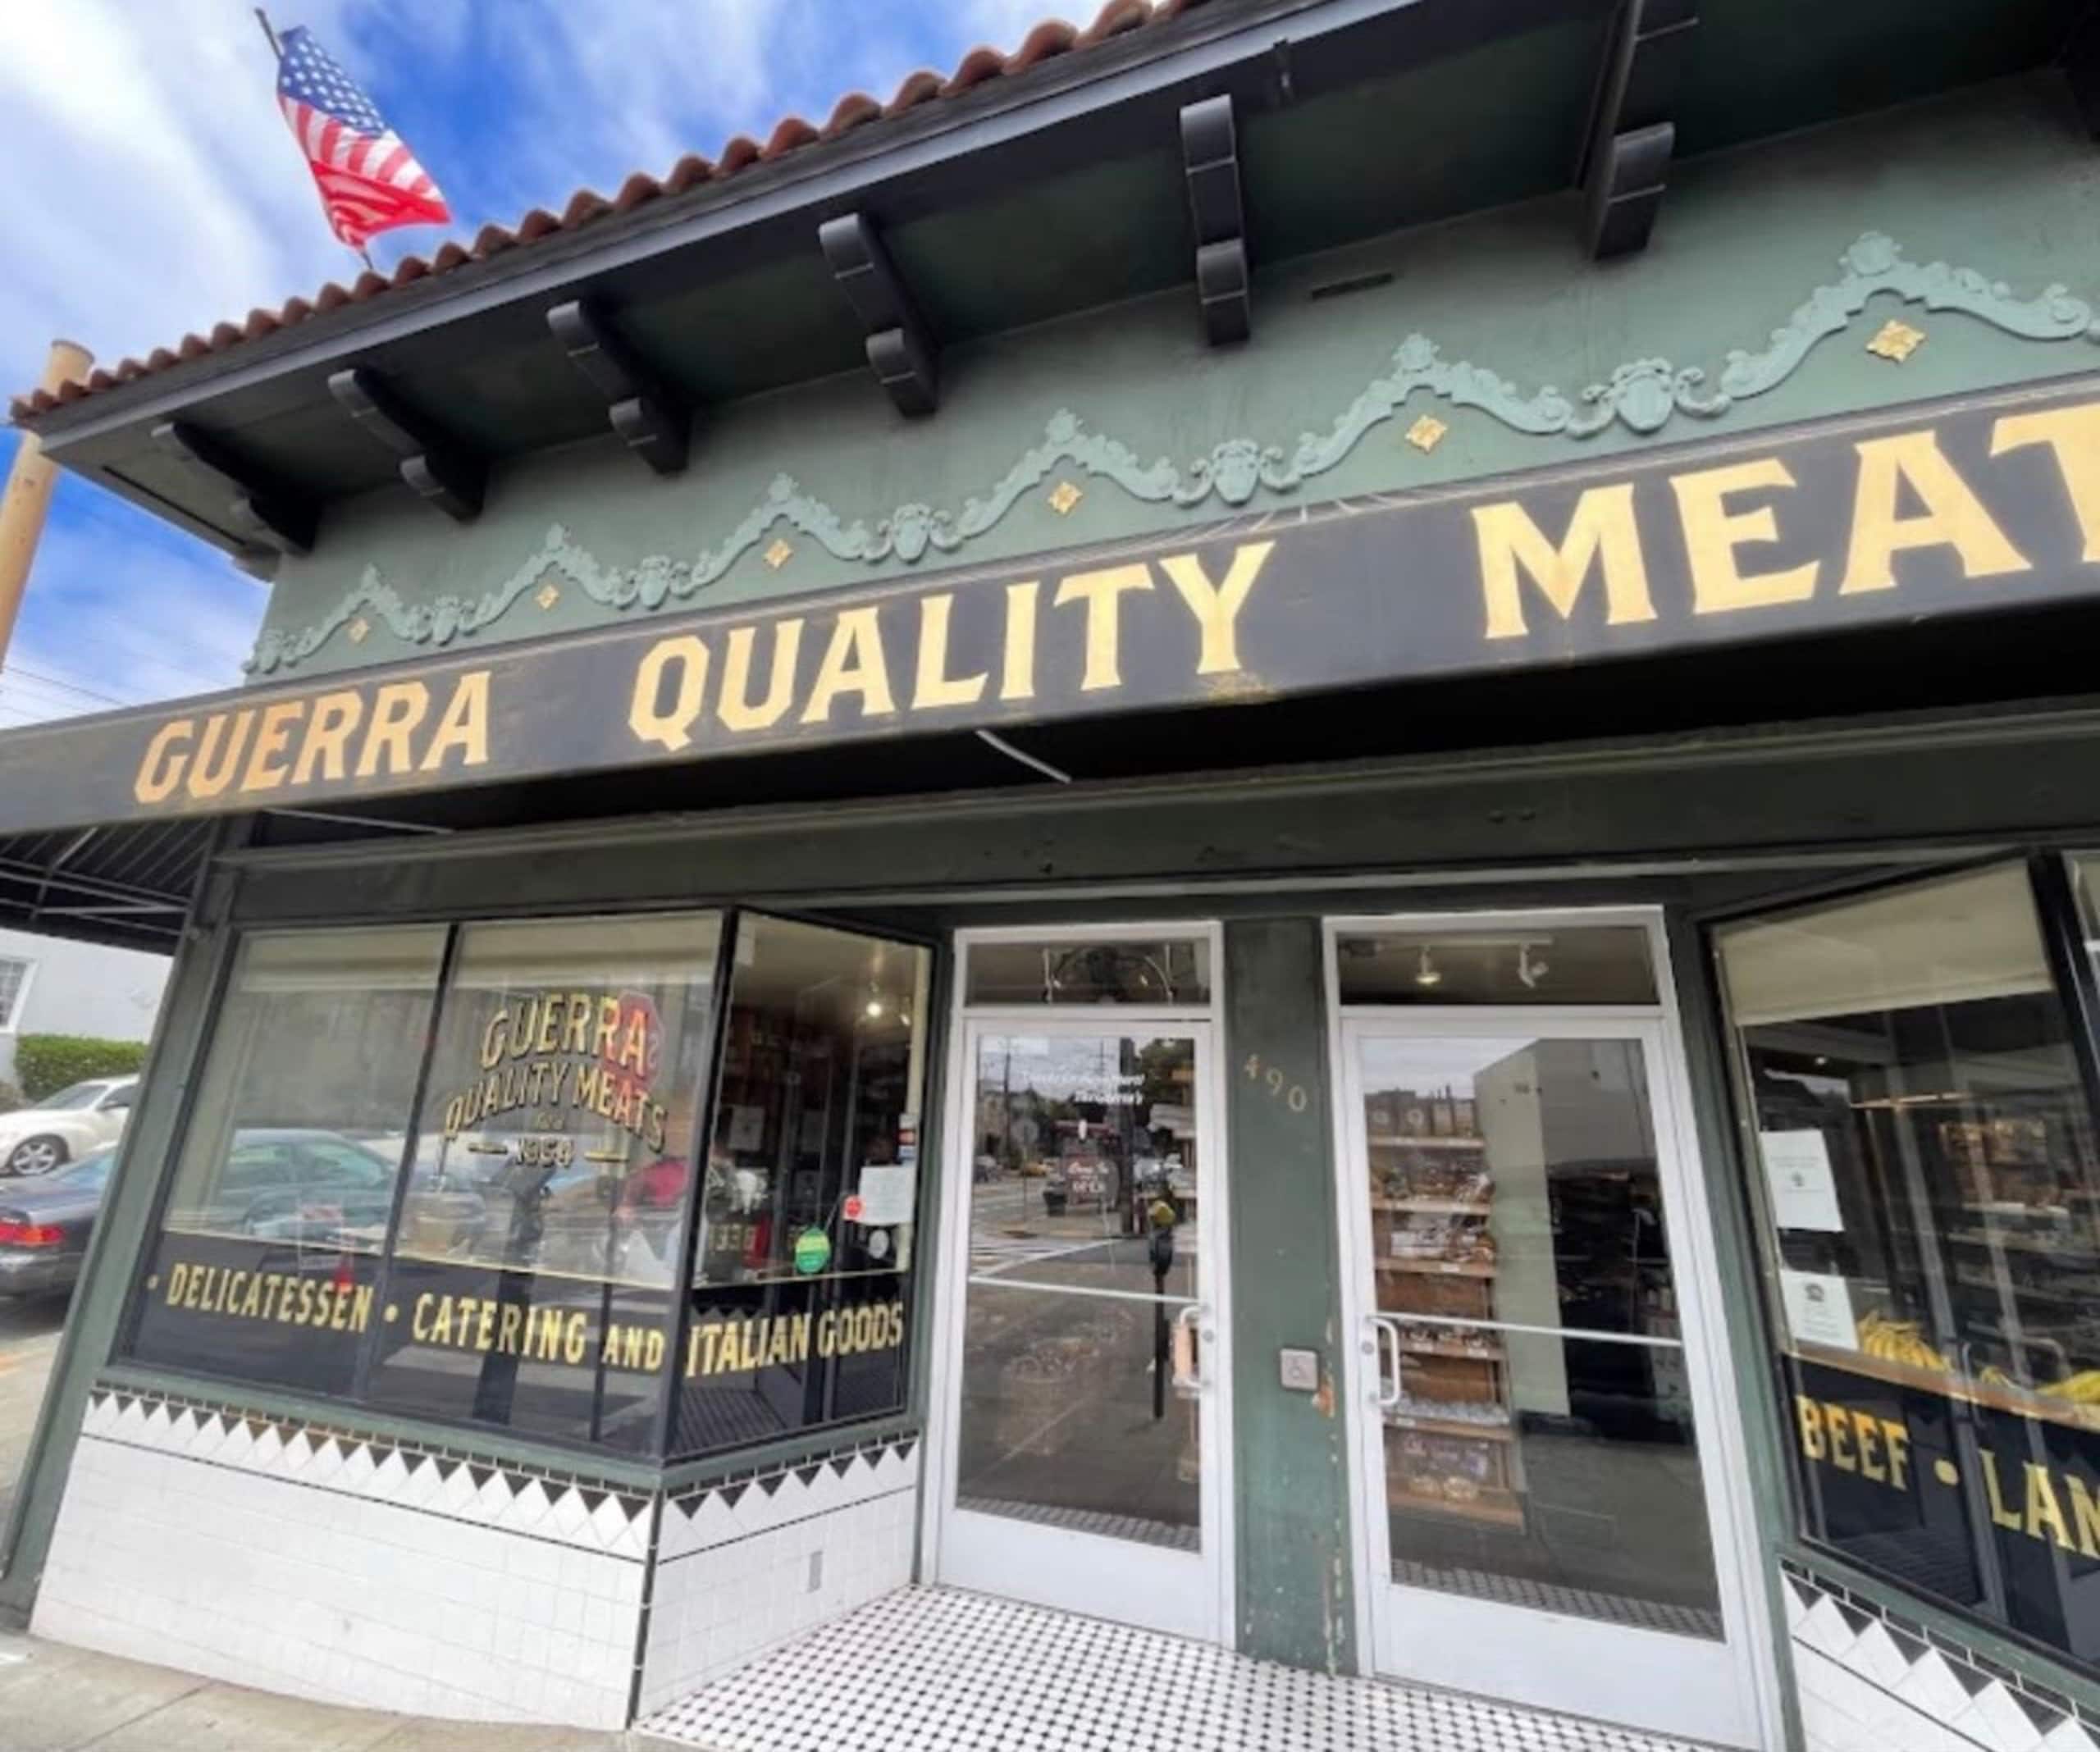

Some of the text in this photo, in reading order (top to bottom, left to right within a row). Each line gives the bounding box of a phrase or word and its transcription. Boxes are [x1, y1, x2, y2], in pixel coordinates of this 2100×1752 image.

[133, 670, 491, 804] GUERRA
[628, 541, 1275, 751] QUALITY
[481, 993, 647, 1075] GUERRA
[444, 1063, 668, 1153] QUALITY MEATS
[166, 1262, 665, 1374] DELICATESSEN CATERING AND
[684, 1301, 904, 1378] ITALIAN GOODS
[1796, 1394, 1910, 1491] BEEF
